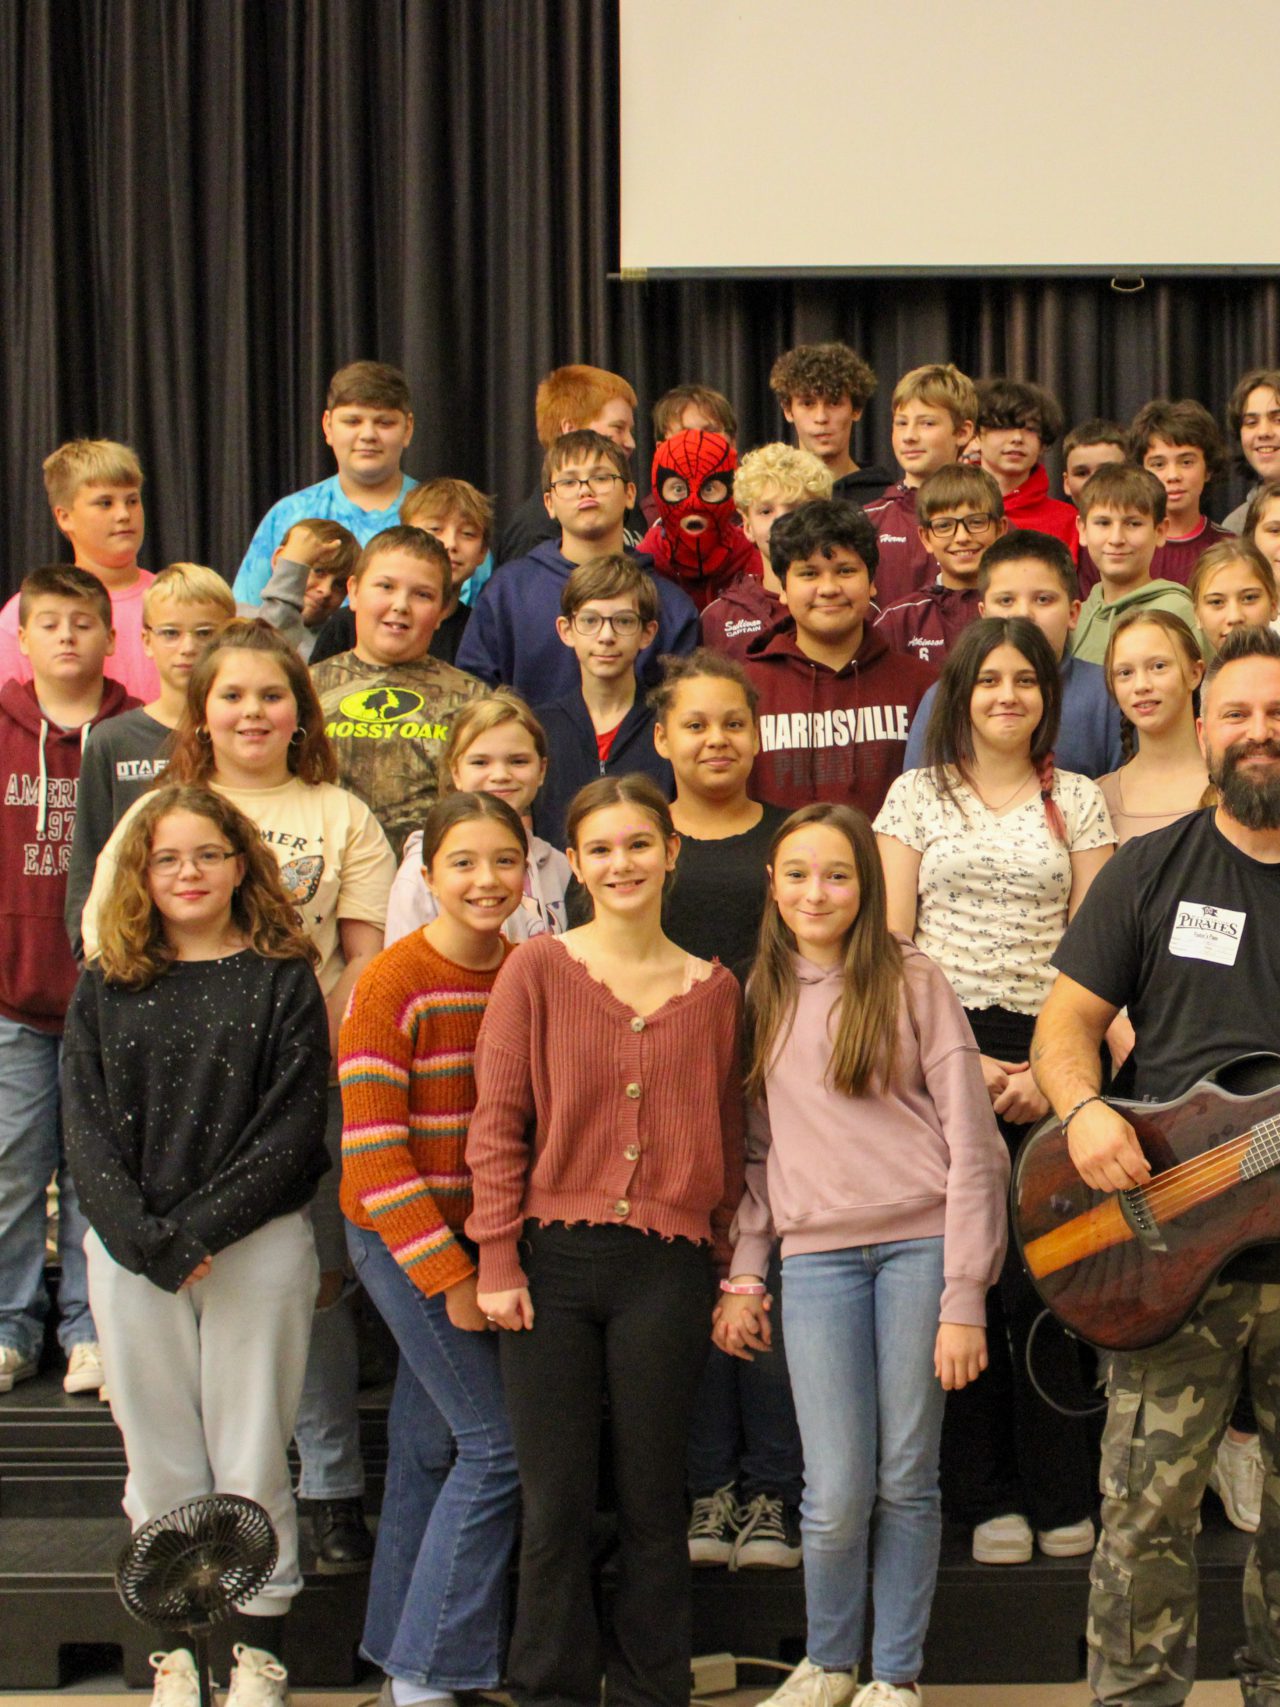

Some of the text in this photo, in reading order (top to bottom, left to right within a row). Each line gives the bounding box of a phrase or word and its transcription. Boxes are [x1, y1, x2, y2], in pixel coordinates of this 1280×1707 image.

[726, 625, 762, 638] CAPTAIN
[399, 721, 449, 742] OAK
[759, 705, 909, 753] HARRISVILLE
